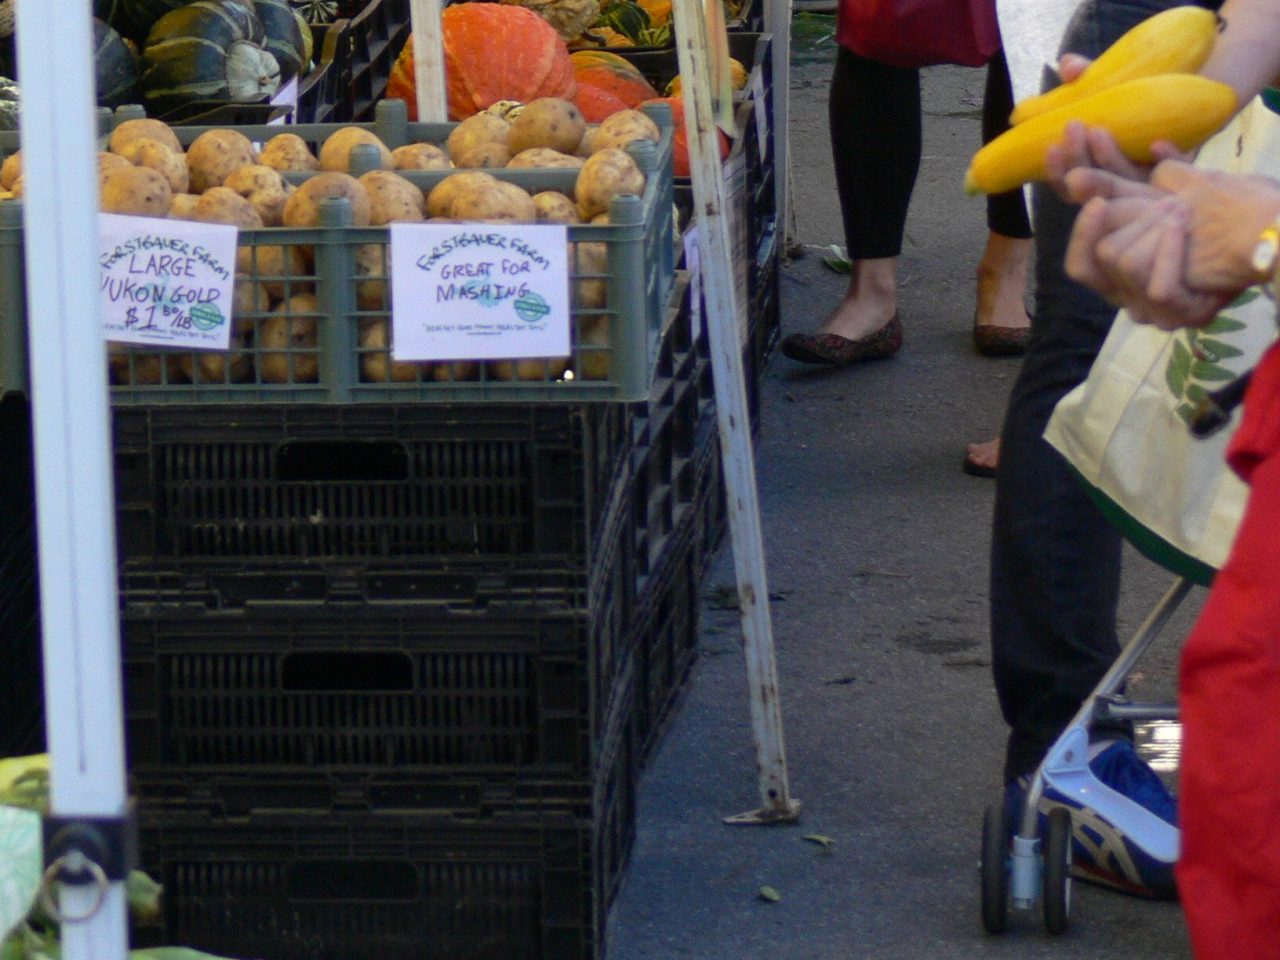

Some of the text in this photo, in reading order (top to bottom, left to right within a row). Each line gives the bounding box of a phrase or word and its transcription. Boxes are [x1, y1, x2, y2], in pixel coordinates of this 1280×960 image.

[129, 253, 196, 278] LARGE
[193, 246, 229, 280] FARM
[510, 239, 550, 270] FARM
[441, 258, 531, 279] GREAT FOR
[171, 286, 220, 304] GOLD
[437, 282, 531, 302] MASHING
